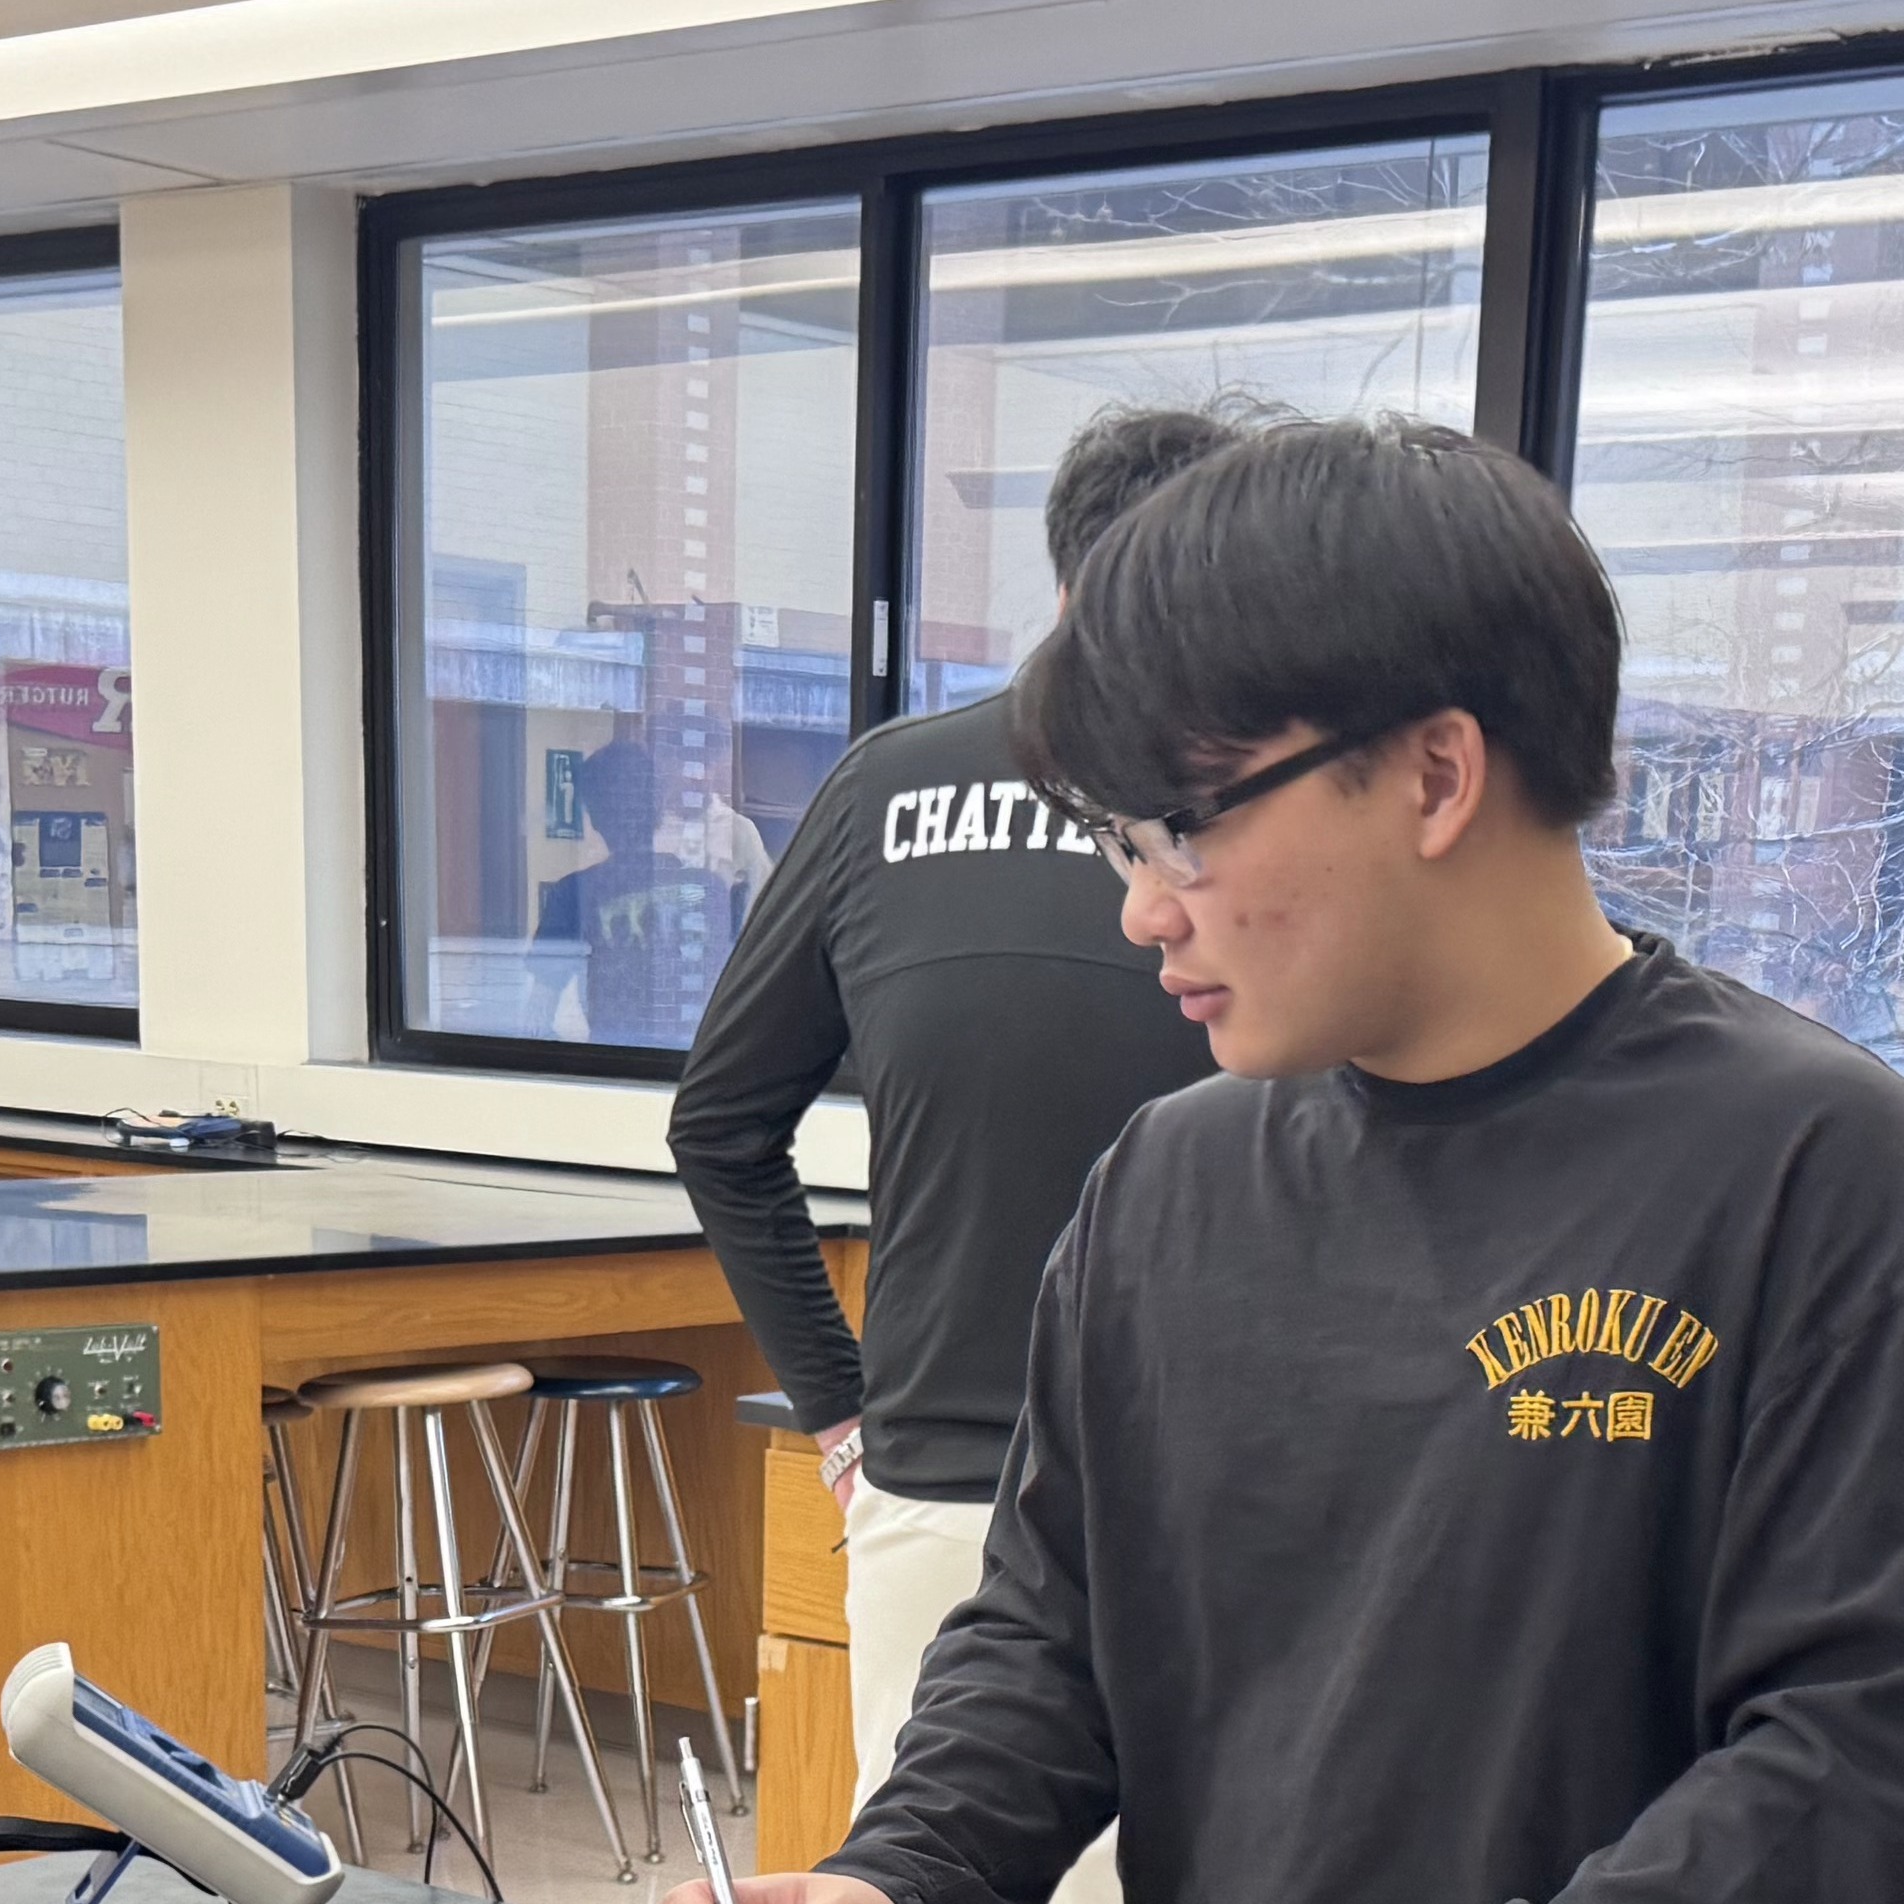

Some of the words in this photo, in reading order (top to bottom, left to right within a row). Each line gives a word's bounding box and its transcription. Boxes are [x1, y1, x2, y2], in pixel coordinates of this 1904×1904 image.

[1465, 1287, 1667, 1390] KENROKU
[1648, 1309, 1719, 1389] EN
[1508, 1388, 1655, 1442] 兼六園
